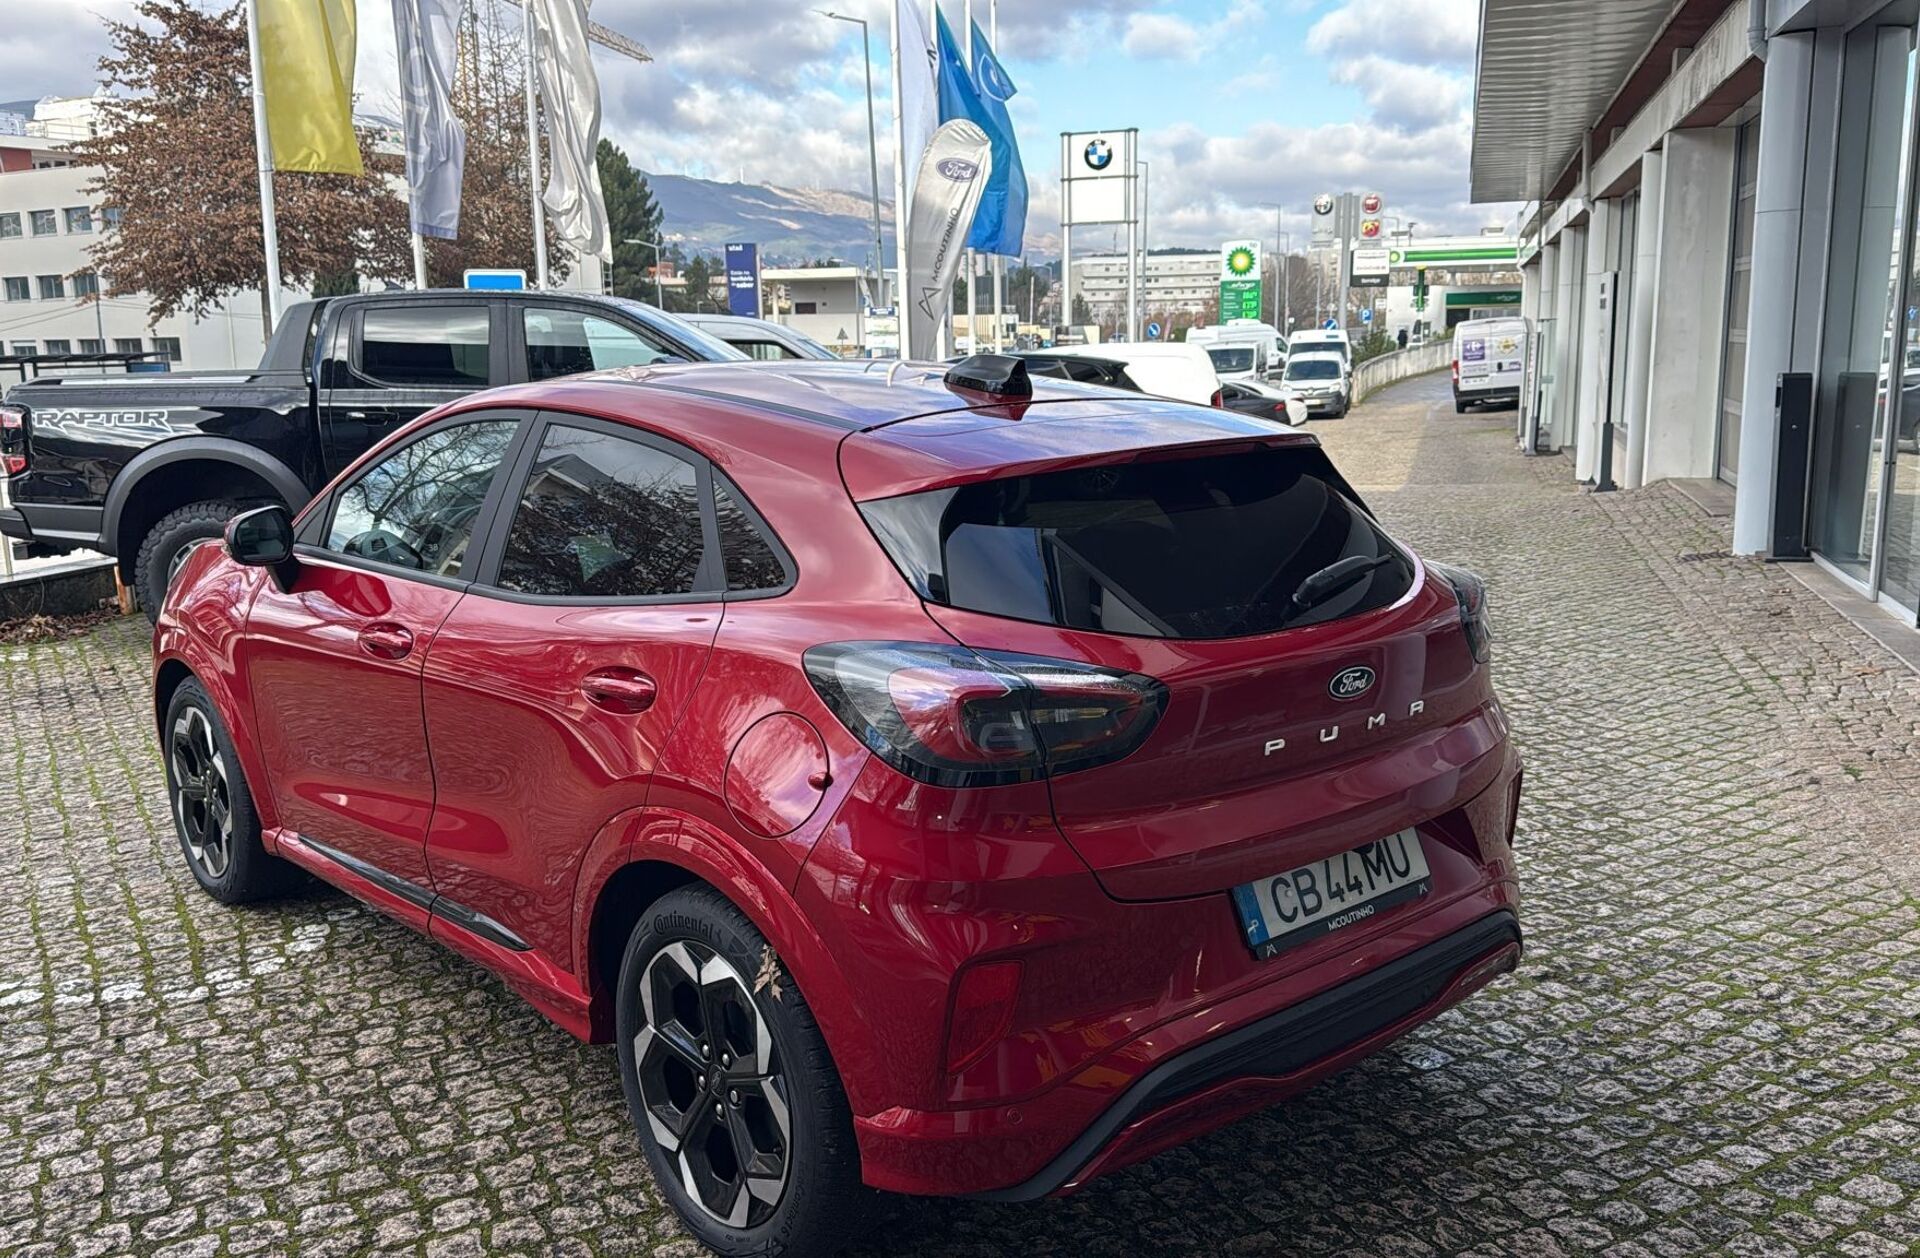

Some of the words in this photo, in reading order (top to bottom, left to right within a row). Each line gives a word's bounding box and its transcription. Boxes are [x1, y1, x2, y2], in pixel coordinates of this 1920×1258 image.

[945, 162, 974, 180] Ford
[932, 207, 959, 283] MCOUTINHO
[34, 409, 173, 434] RAPTOR
[1340, 672, 1369, 693] Ford
[653, 909, 715, 940] Continental
[1327, 904, 1375, 931] MCOUTINHO
